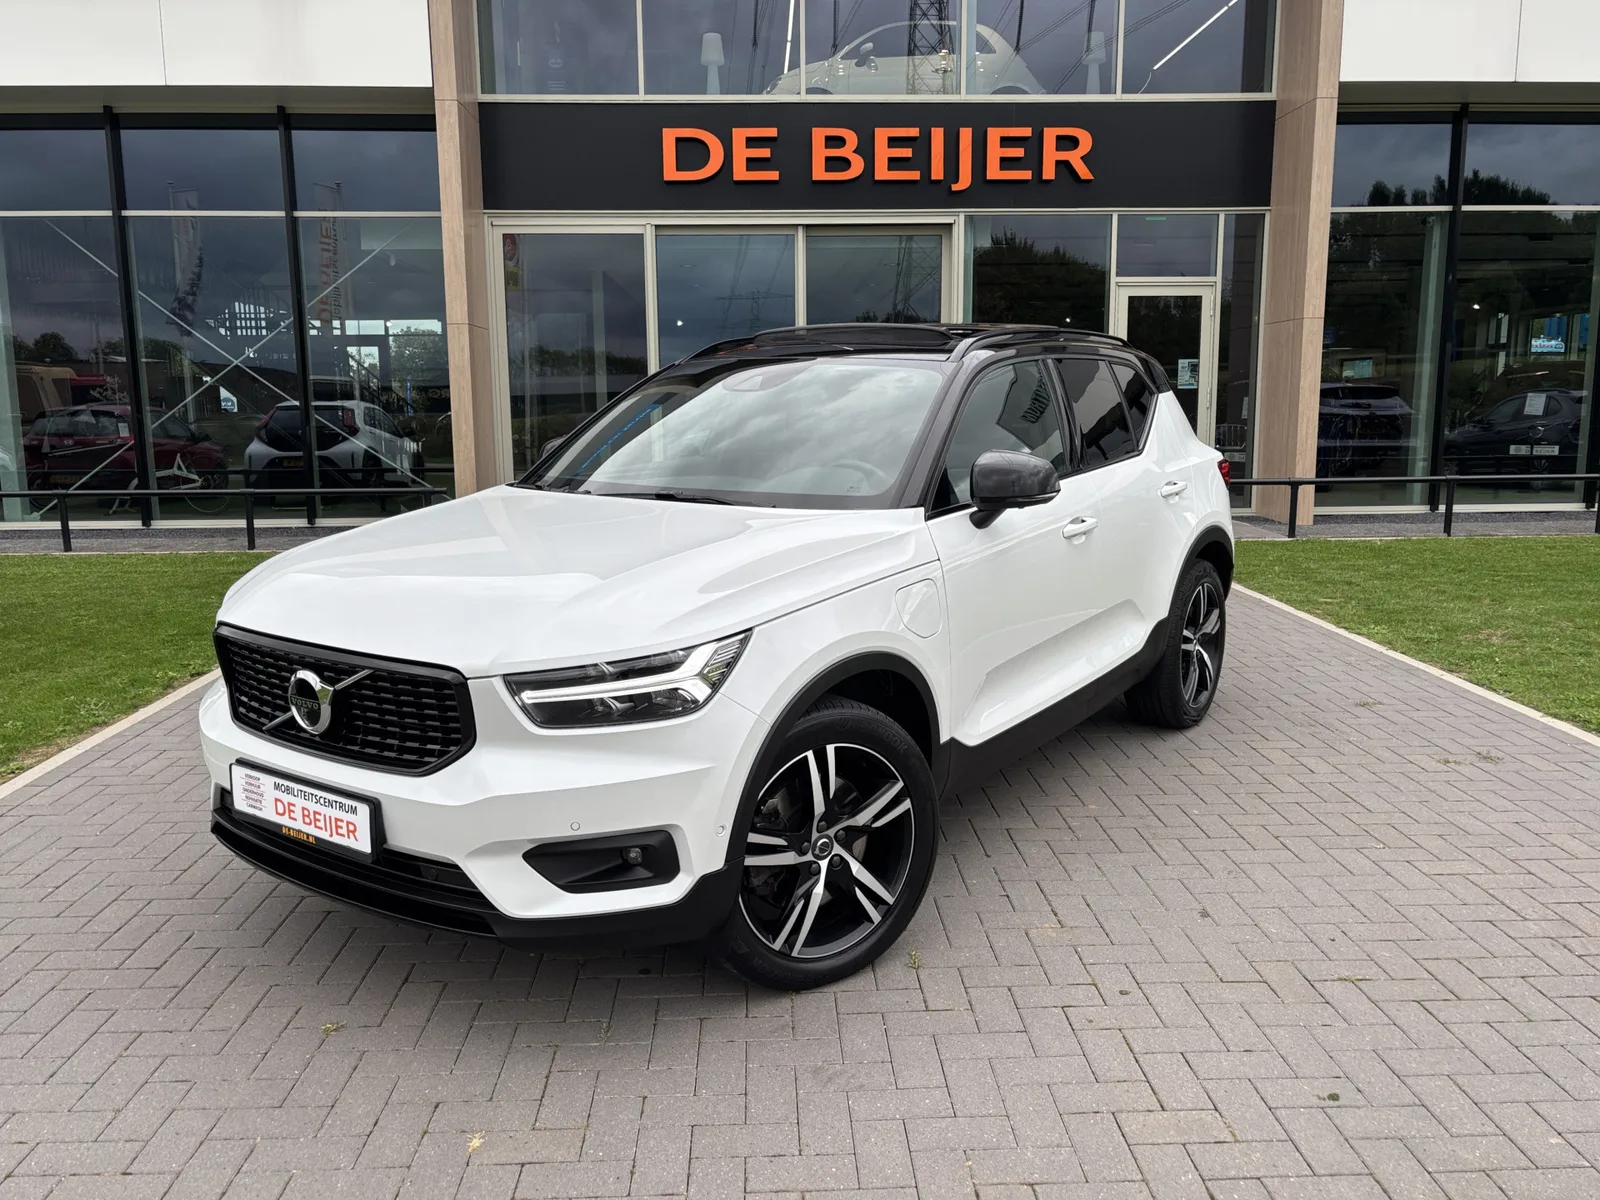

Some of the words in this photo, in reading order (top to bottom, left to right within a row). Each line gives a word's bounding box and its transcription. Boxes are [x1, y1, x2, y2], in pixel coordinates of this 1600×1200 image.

[661, 127, 780, 182] DE
[811, 127, 1095, 192] BEIJER
[291, 697, 319, 710] VOLVO
[273, 781, 358, 816] MOBILITEITSCENTRUM
[274, 797, 298, 822] DE
[302, 806, 359, 842] BEIJER
